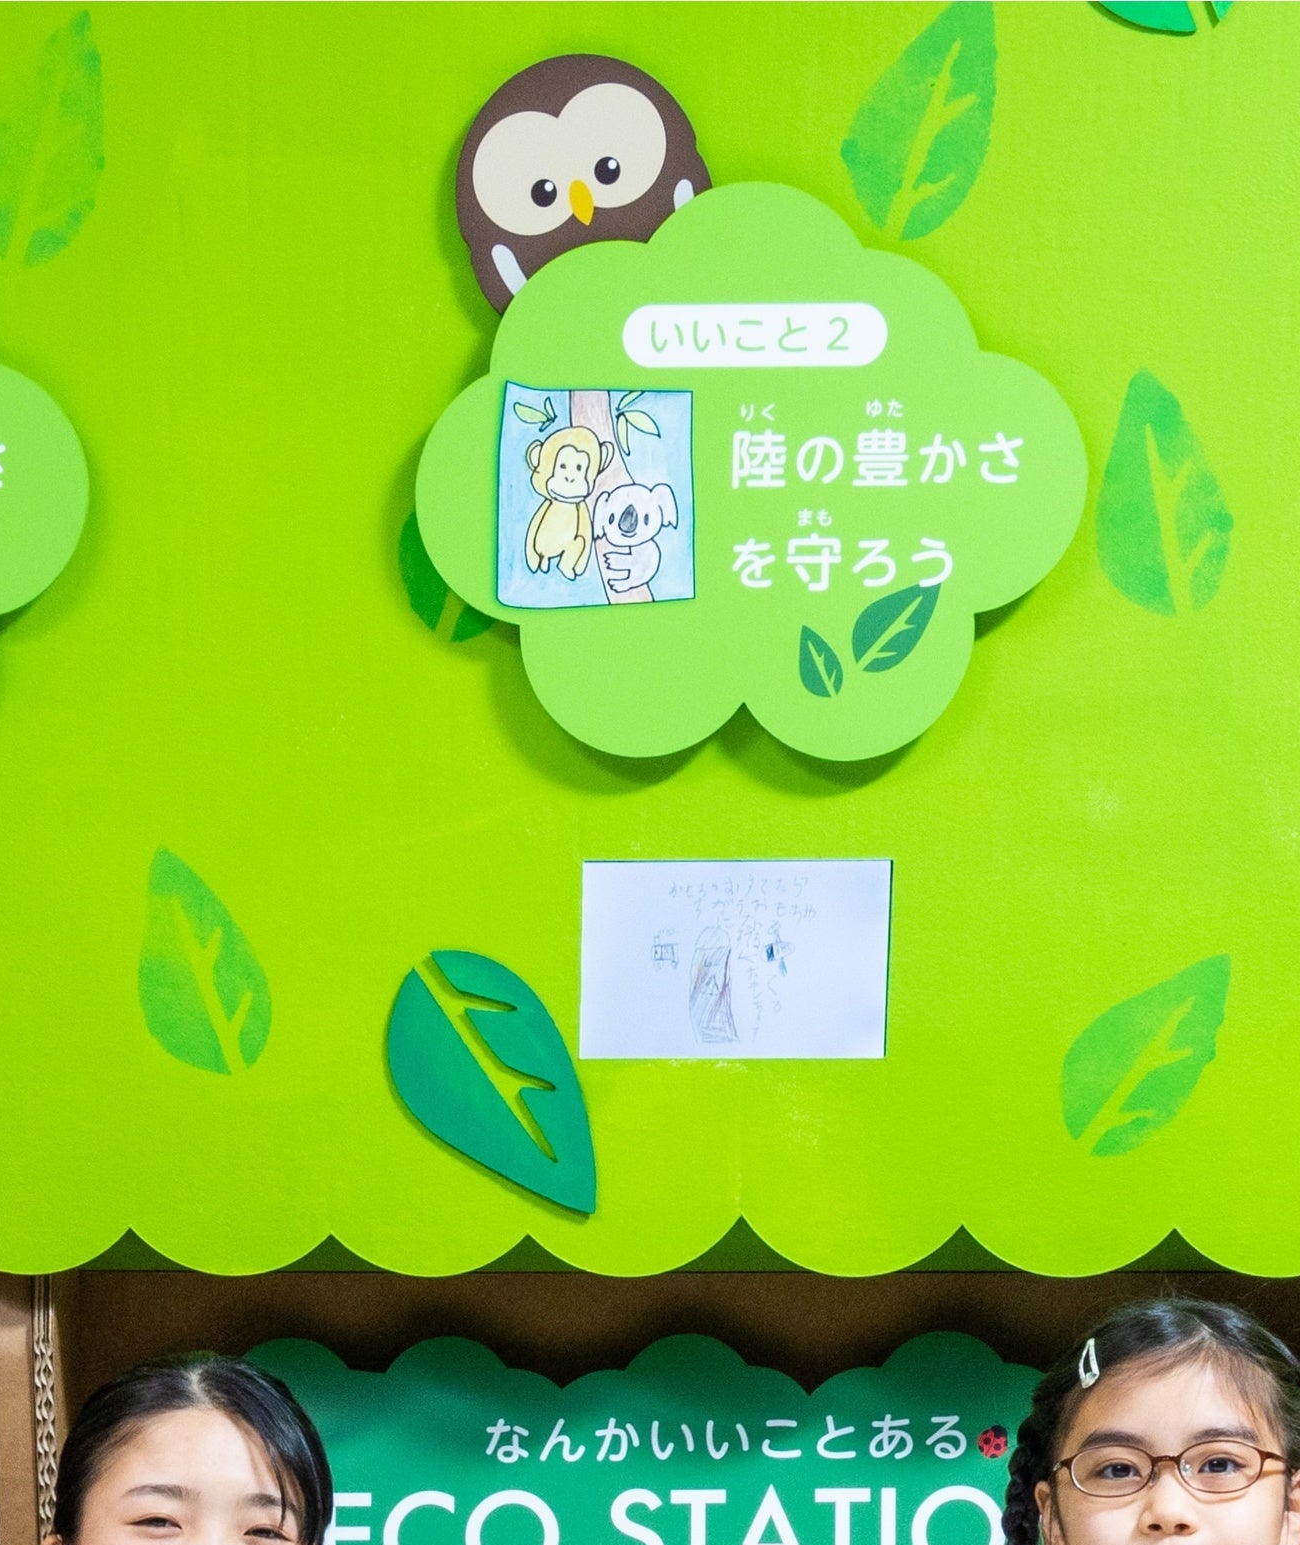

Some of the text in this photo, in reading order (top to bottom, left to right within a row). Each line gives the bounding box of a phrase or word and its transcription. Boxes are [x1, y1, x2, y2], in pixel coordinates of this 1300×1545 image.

[740, 403, 775, 423] りく
[865, 398, 903, 418] ゆた
[731, 427, 1024, 490] 陸の豊かさ
[797, 508, 833, 527] まも
[731, 531, 954, 592] を守ろう
[485, 1414, 967, 1464] なんかいいことある
